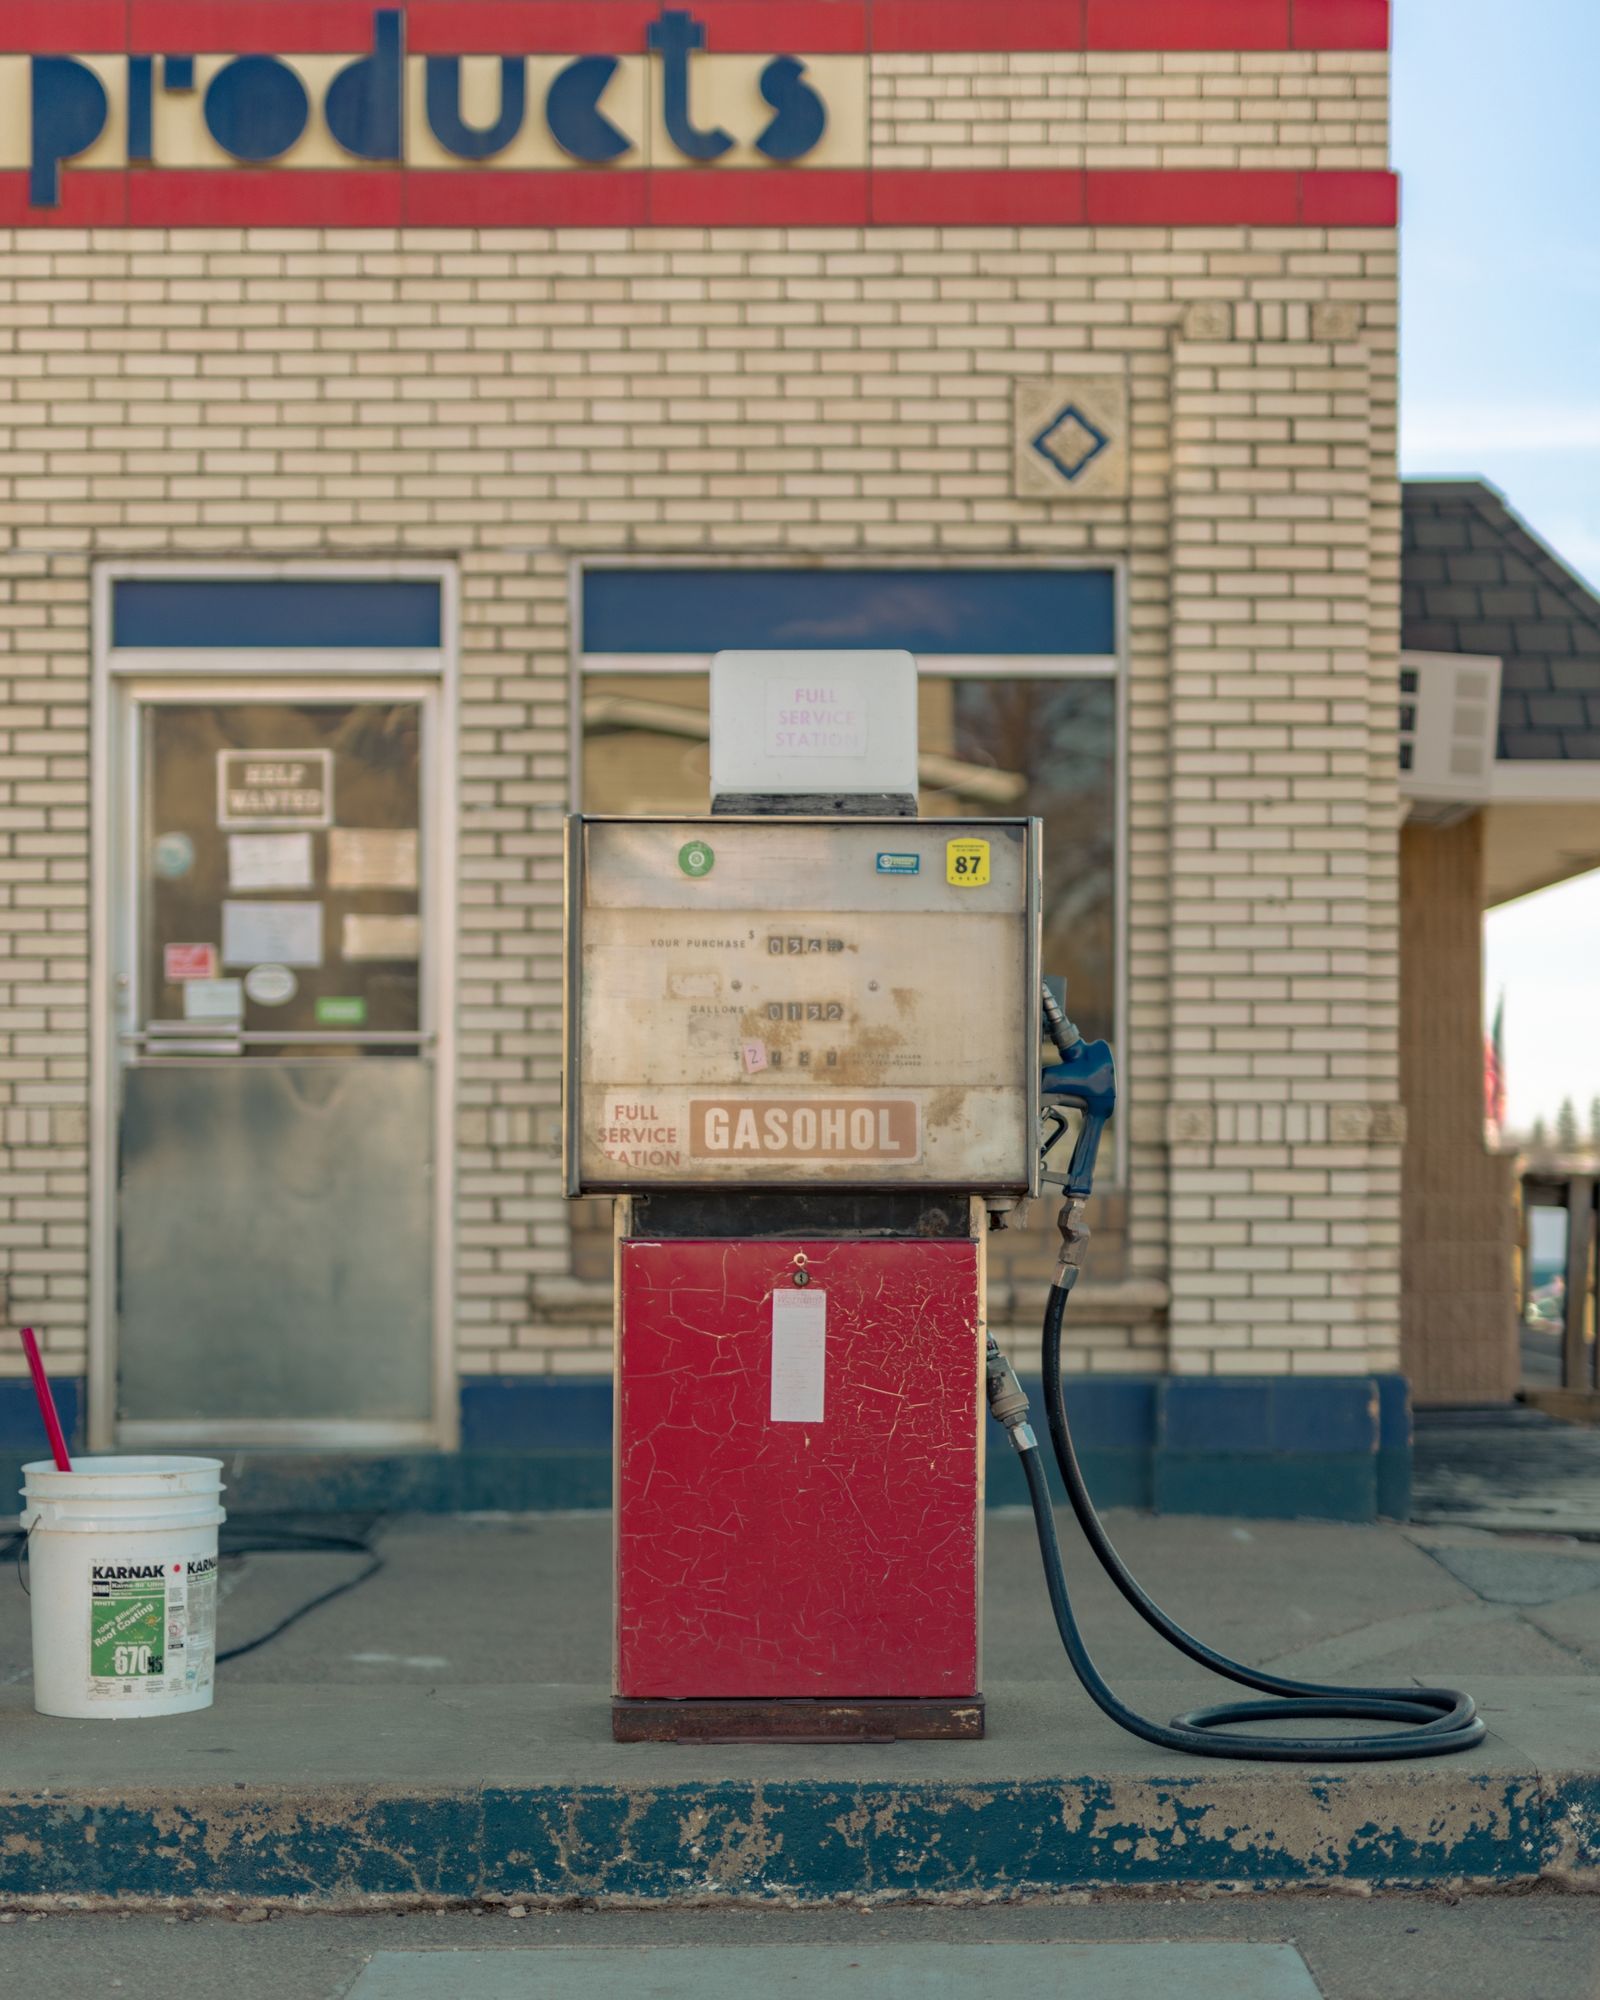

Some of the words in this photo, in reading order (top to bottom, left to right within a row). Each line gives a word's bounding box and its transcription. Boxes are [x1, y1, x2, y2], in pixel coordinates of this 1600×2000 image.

[30, 9, 826, 208] products
[794, 687, 838, 703] FULL
[778, 710, 857, 725] SERVICE
[775, 732, 860, 747] STATION
[244, 763, 306, 785] HELP
[955, 855, 981, 874] 87
[650, 939, 680, 948] YOUR
[687, 939, 746, 949] PURCHASE
[690, 1005, 745, 1014] GALLONS
[614, 1104, 659, 1121] FULL
[597, 1127, 677, 1143] SERVICE
[704, 1107, 900, 1150] GASOHOL
[605, 1150, 680, 1167] TATION
[92, 1565, 165, 1579] KARNAK
[94, 1628, 117, 1647] Roof
[117, 1603, 155, 1631] Coating
